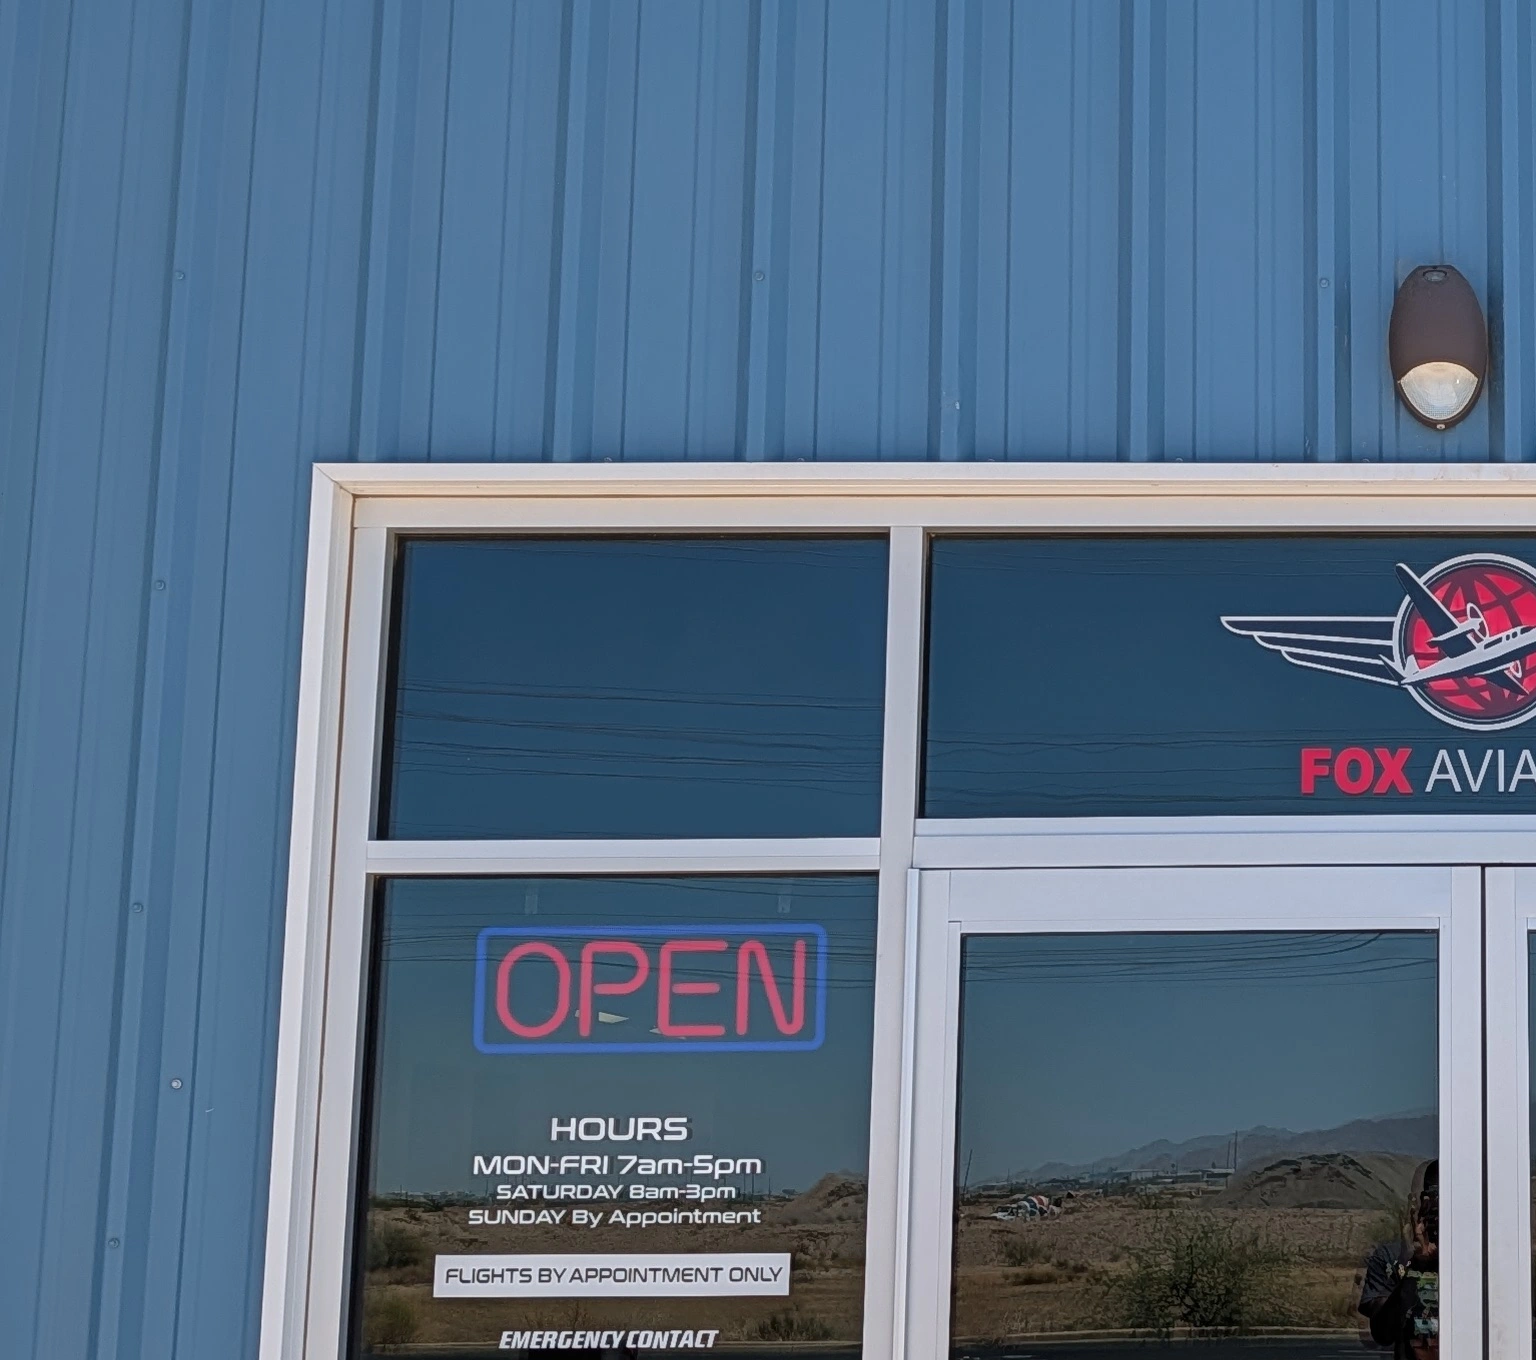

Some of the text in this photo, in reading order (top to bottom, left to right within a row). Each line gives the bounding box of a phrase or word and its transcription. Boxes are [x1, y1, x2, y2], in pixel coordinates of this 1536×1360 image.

[1300, 747, 1413, 795] FOX
[495, 939, 807, 1038] OPEN
[551, 1117, 689, 1141] HOURS
[473, 1154, 762, 1180] MON-FRI 7am-5pm
[496, 1184, 736, 1203] SATURDAY 8am-3pm
[468, 1208, 762, 1229] SUNDAY By Appointment
[445, 1266, 783, 1284] FLIGHTS BY APPOINTMENT ONLY
[499, 1329, 719, 1349] EMERGENCY CONTACT
